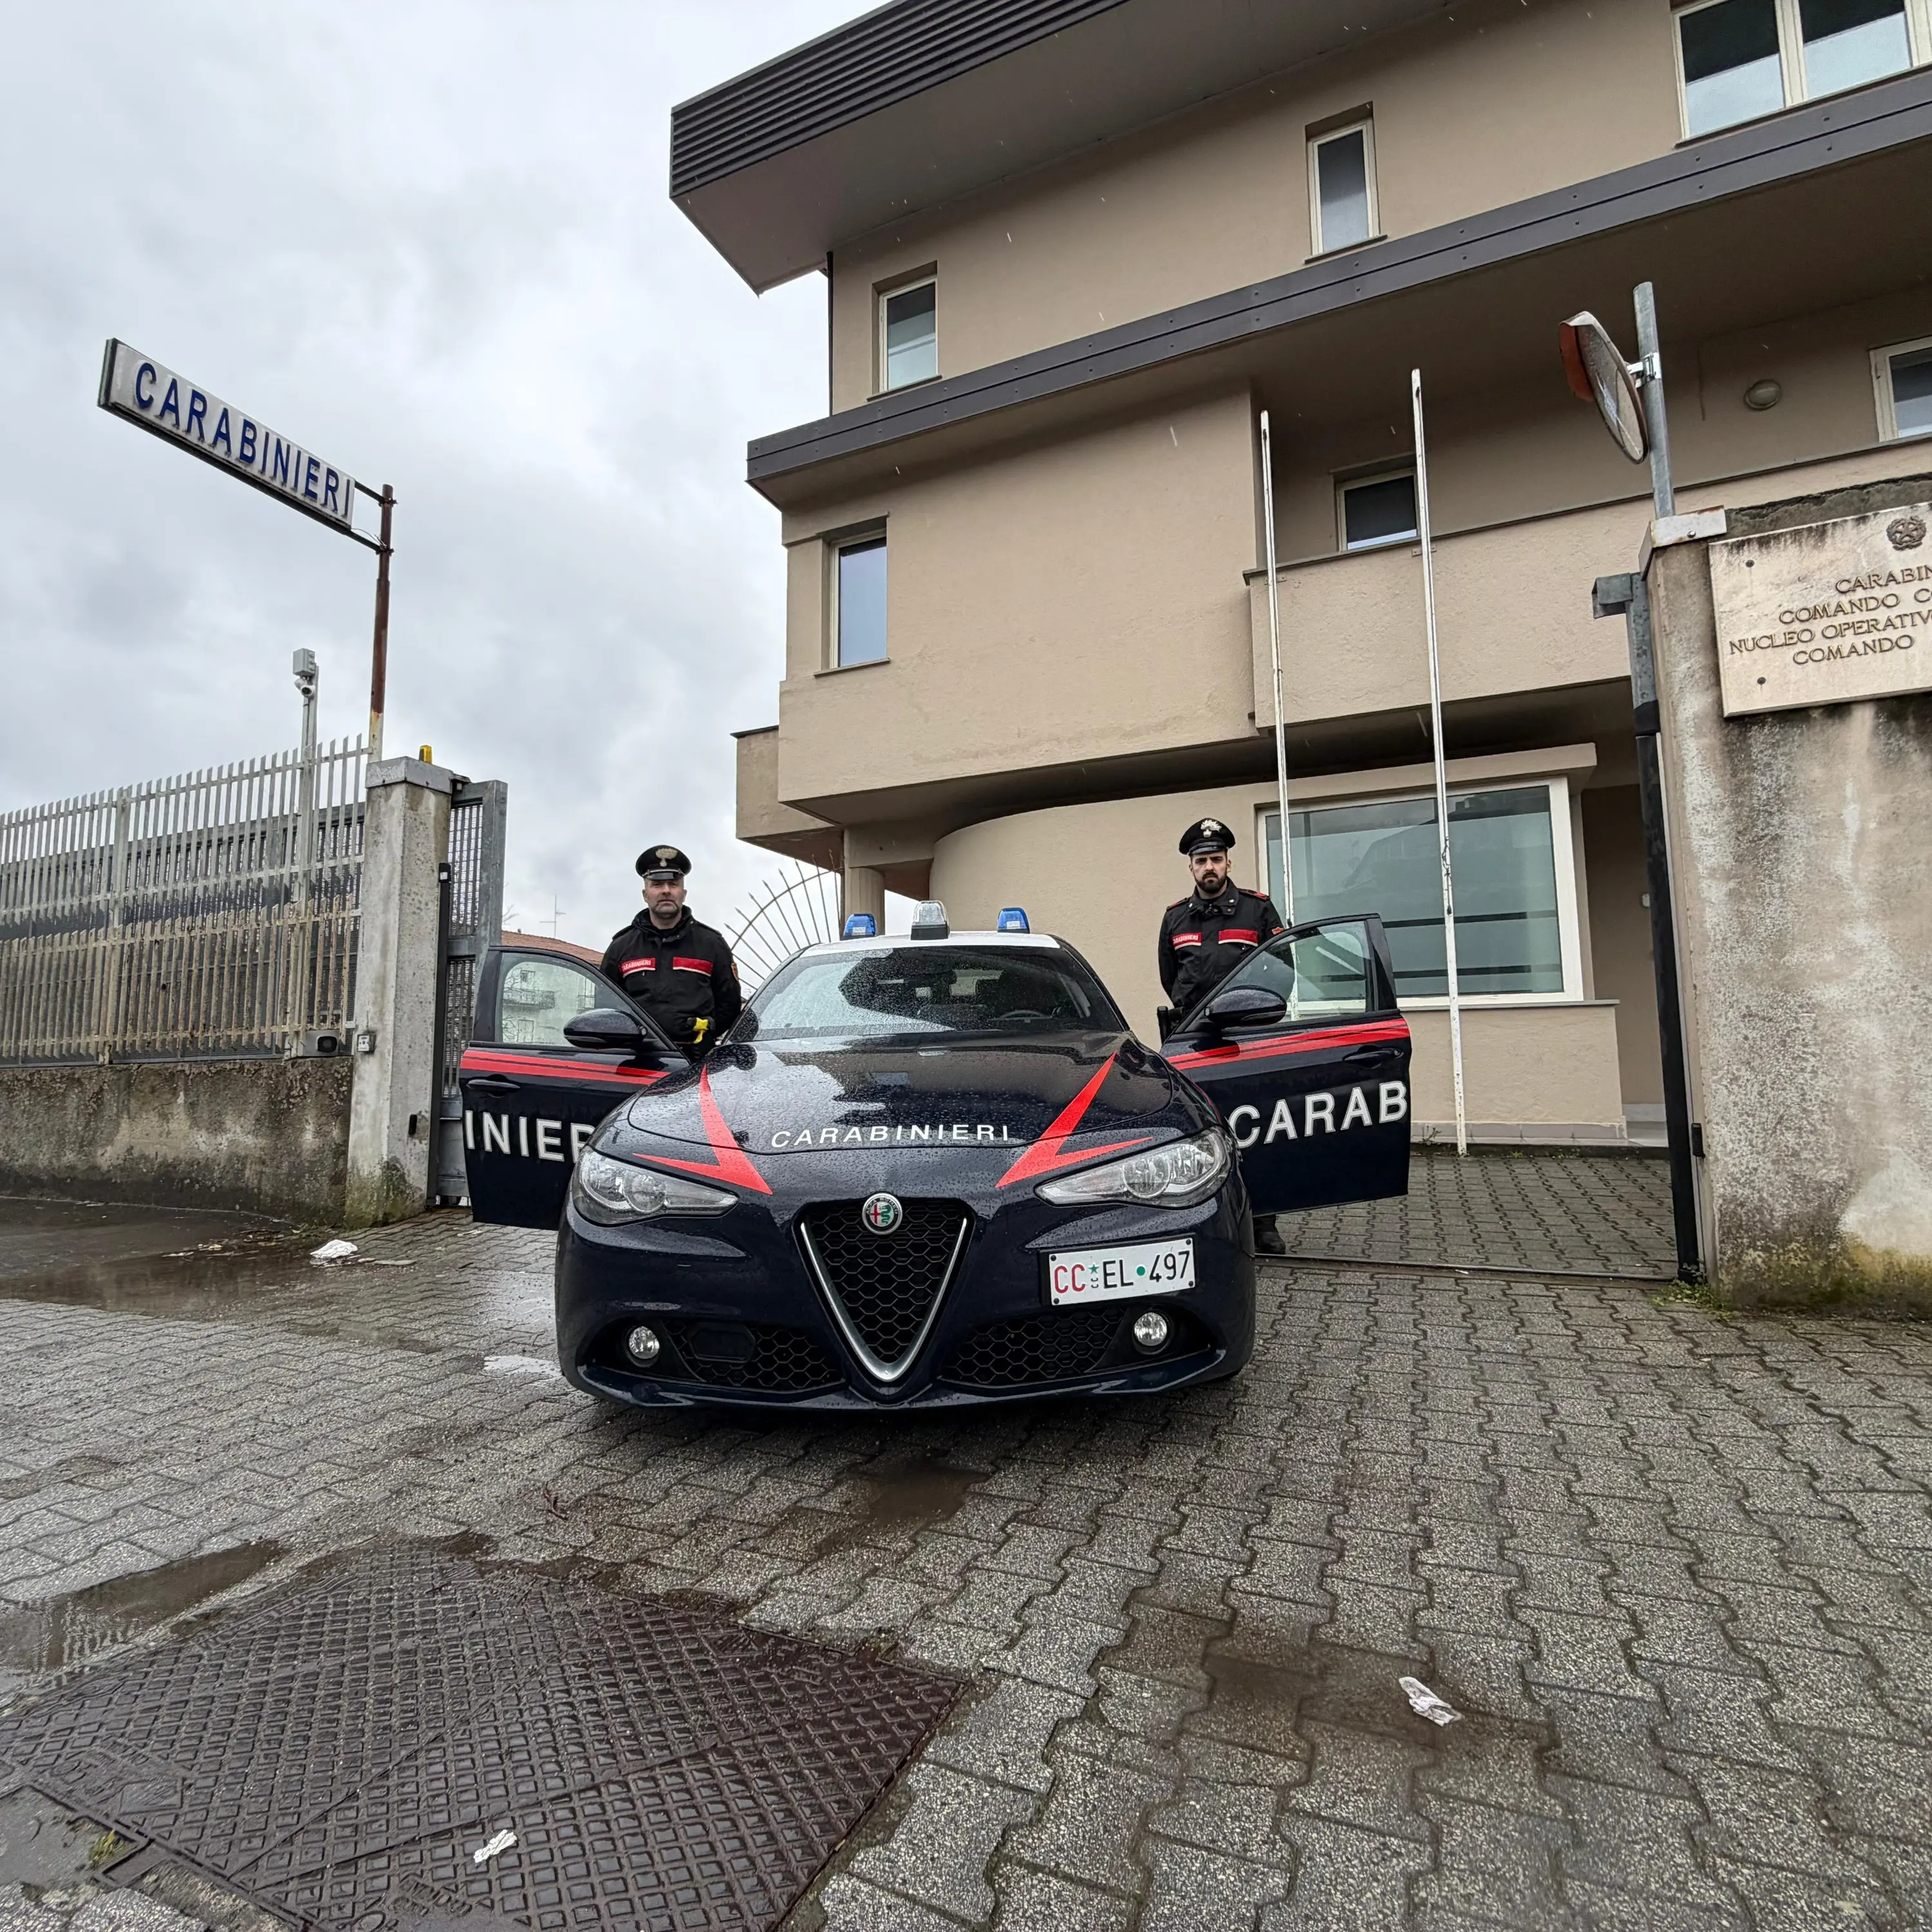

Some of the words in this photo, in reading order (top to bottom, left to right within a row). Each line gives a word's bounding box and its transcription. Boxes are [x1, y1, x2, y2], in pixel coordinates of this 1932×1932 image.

[135, 362, 352, 518] CARABINIERI
[1779, 593, 1900, 624] COMANDO
[1913, 588, 1932, 603] C
[1728, 629, 1815, 655] NUCLEO
[1821, 609, 1932, 639] OPERATIV
[1792, 634, 1915, 665] COMANDO
[1228, 1080, 1408, 1150] CARAB
[771, 1124, 1009, 1148] CARABINIERI
[866, 1199, 877, 1215] ALFA
[880, 1197, 898, 1215] ROMEO
[1054, 1264, 1086, 1294] CC
[1103, 1259, 1134, 1289] EL
[1149, 1250, 1190, 1283] 497
